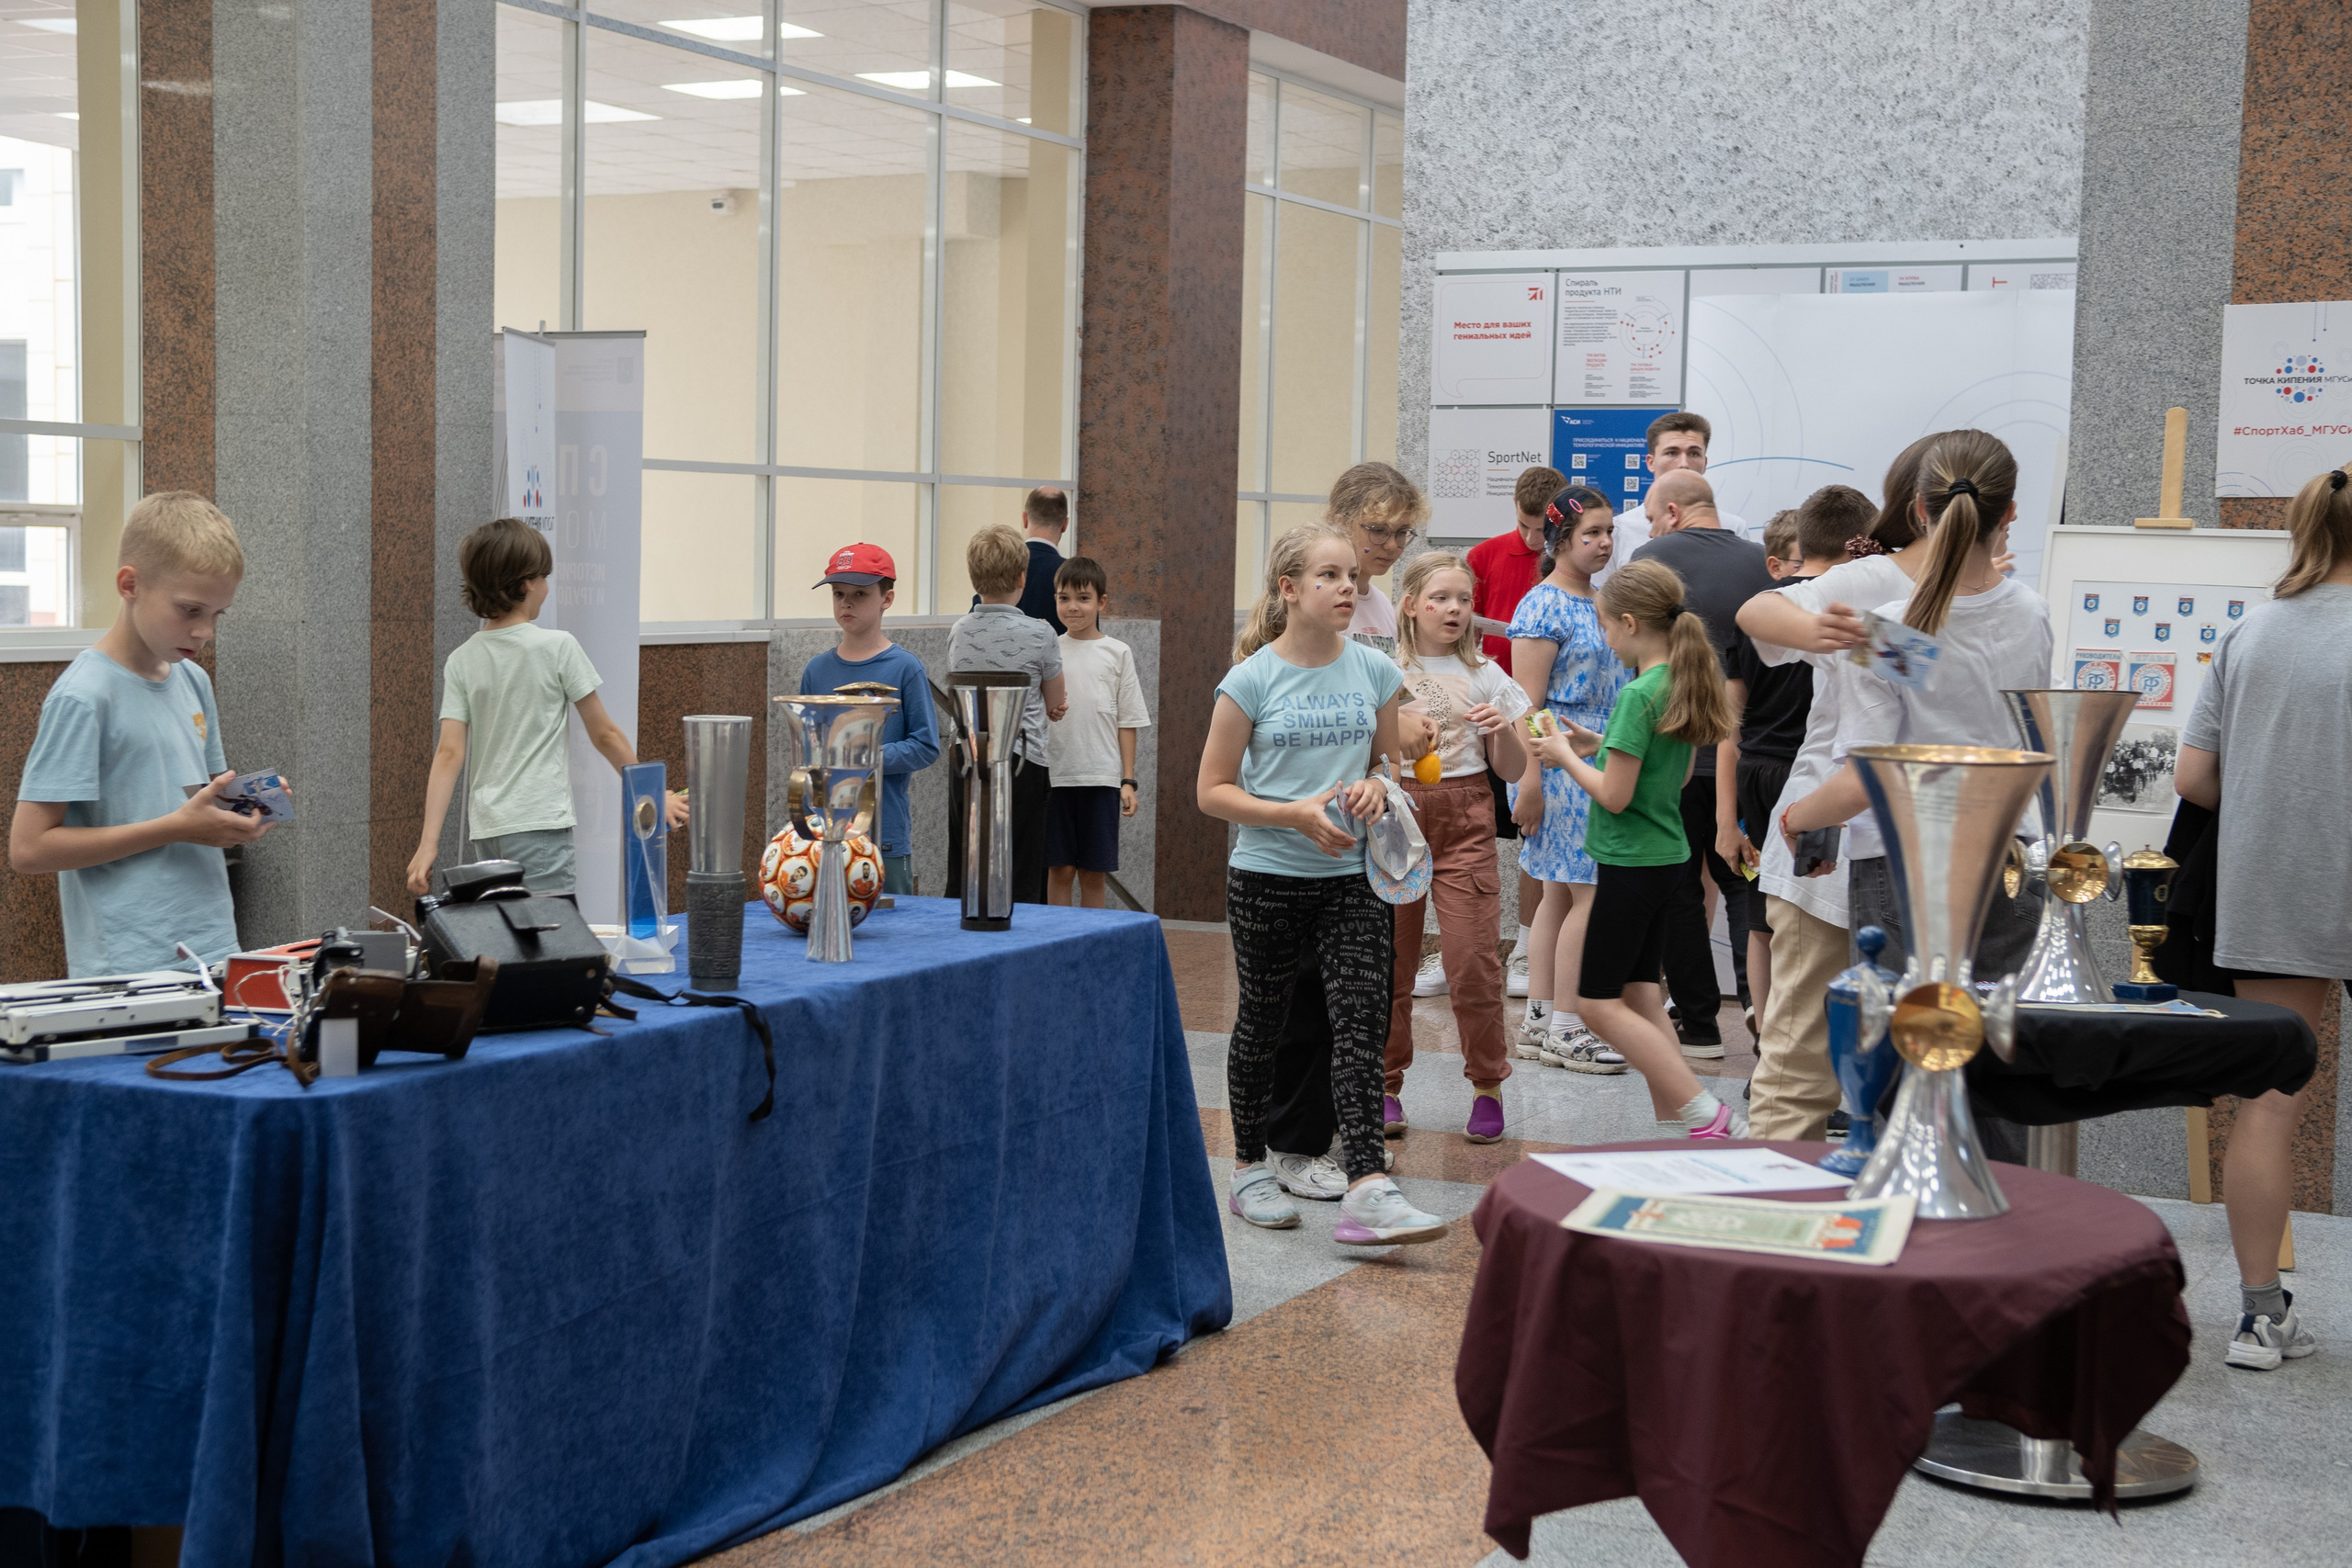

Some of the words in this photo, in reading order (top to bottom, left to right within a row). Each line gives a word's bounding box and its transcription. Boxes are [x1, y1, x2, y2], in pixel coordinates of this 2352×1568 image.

[1565, 278, 1599, 288] Спираль
[1565, 289, 1601, 298] продукта
[1603, 287, 1622, 296] НТИ
[1483, 321, 1500, 330] для
[1509, 331, 1532, 340] идей
[2277, 376, 2323, 384] КИПЕНИЯ
[1487, 450, 1542, 466] SportNet
[1282, 692, 1364, 711] ALWAYS
[1283, 712, 1347, 728] SMILE
[1356, 710, 1368, 726] &
[1272, 732, 1301, 748] BE
[1309, 729, 1374, 747] HAPPY
[1363, 898, 1385, 910] THAT
[1340, 919, 1373, 933] LOVE
[1340, 966, 1355, 976] BE
[1358, 968, 1383, 981] THAT
[1239, 1043, 1249, 1052] Do
